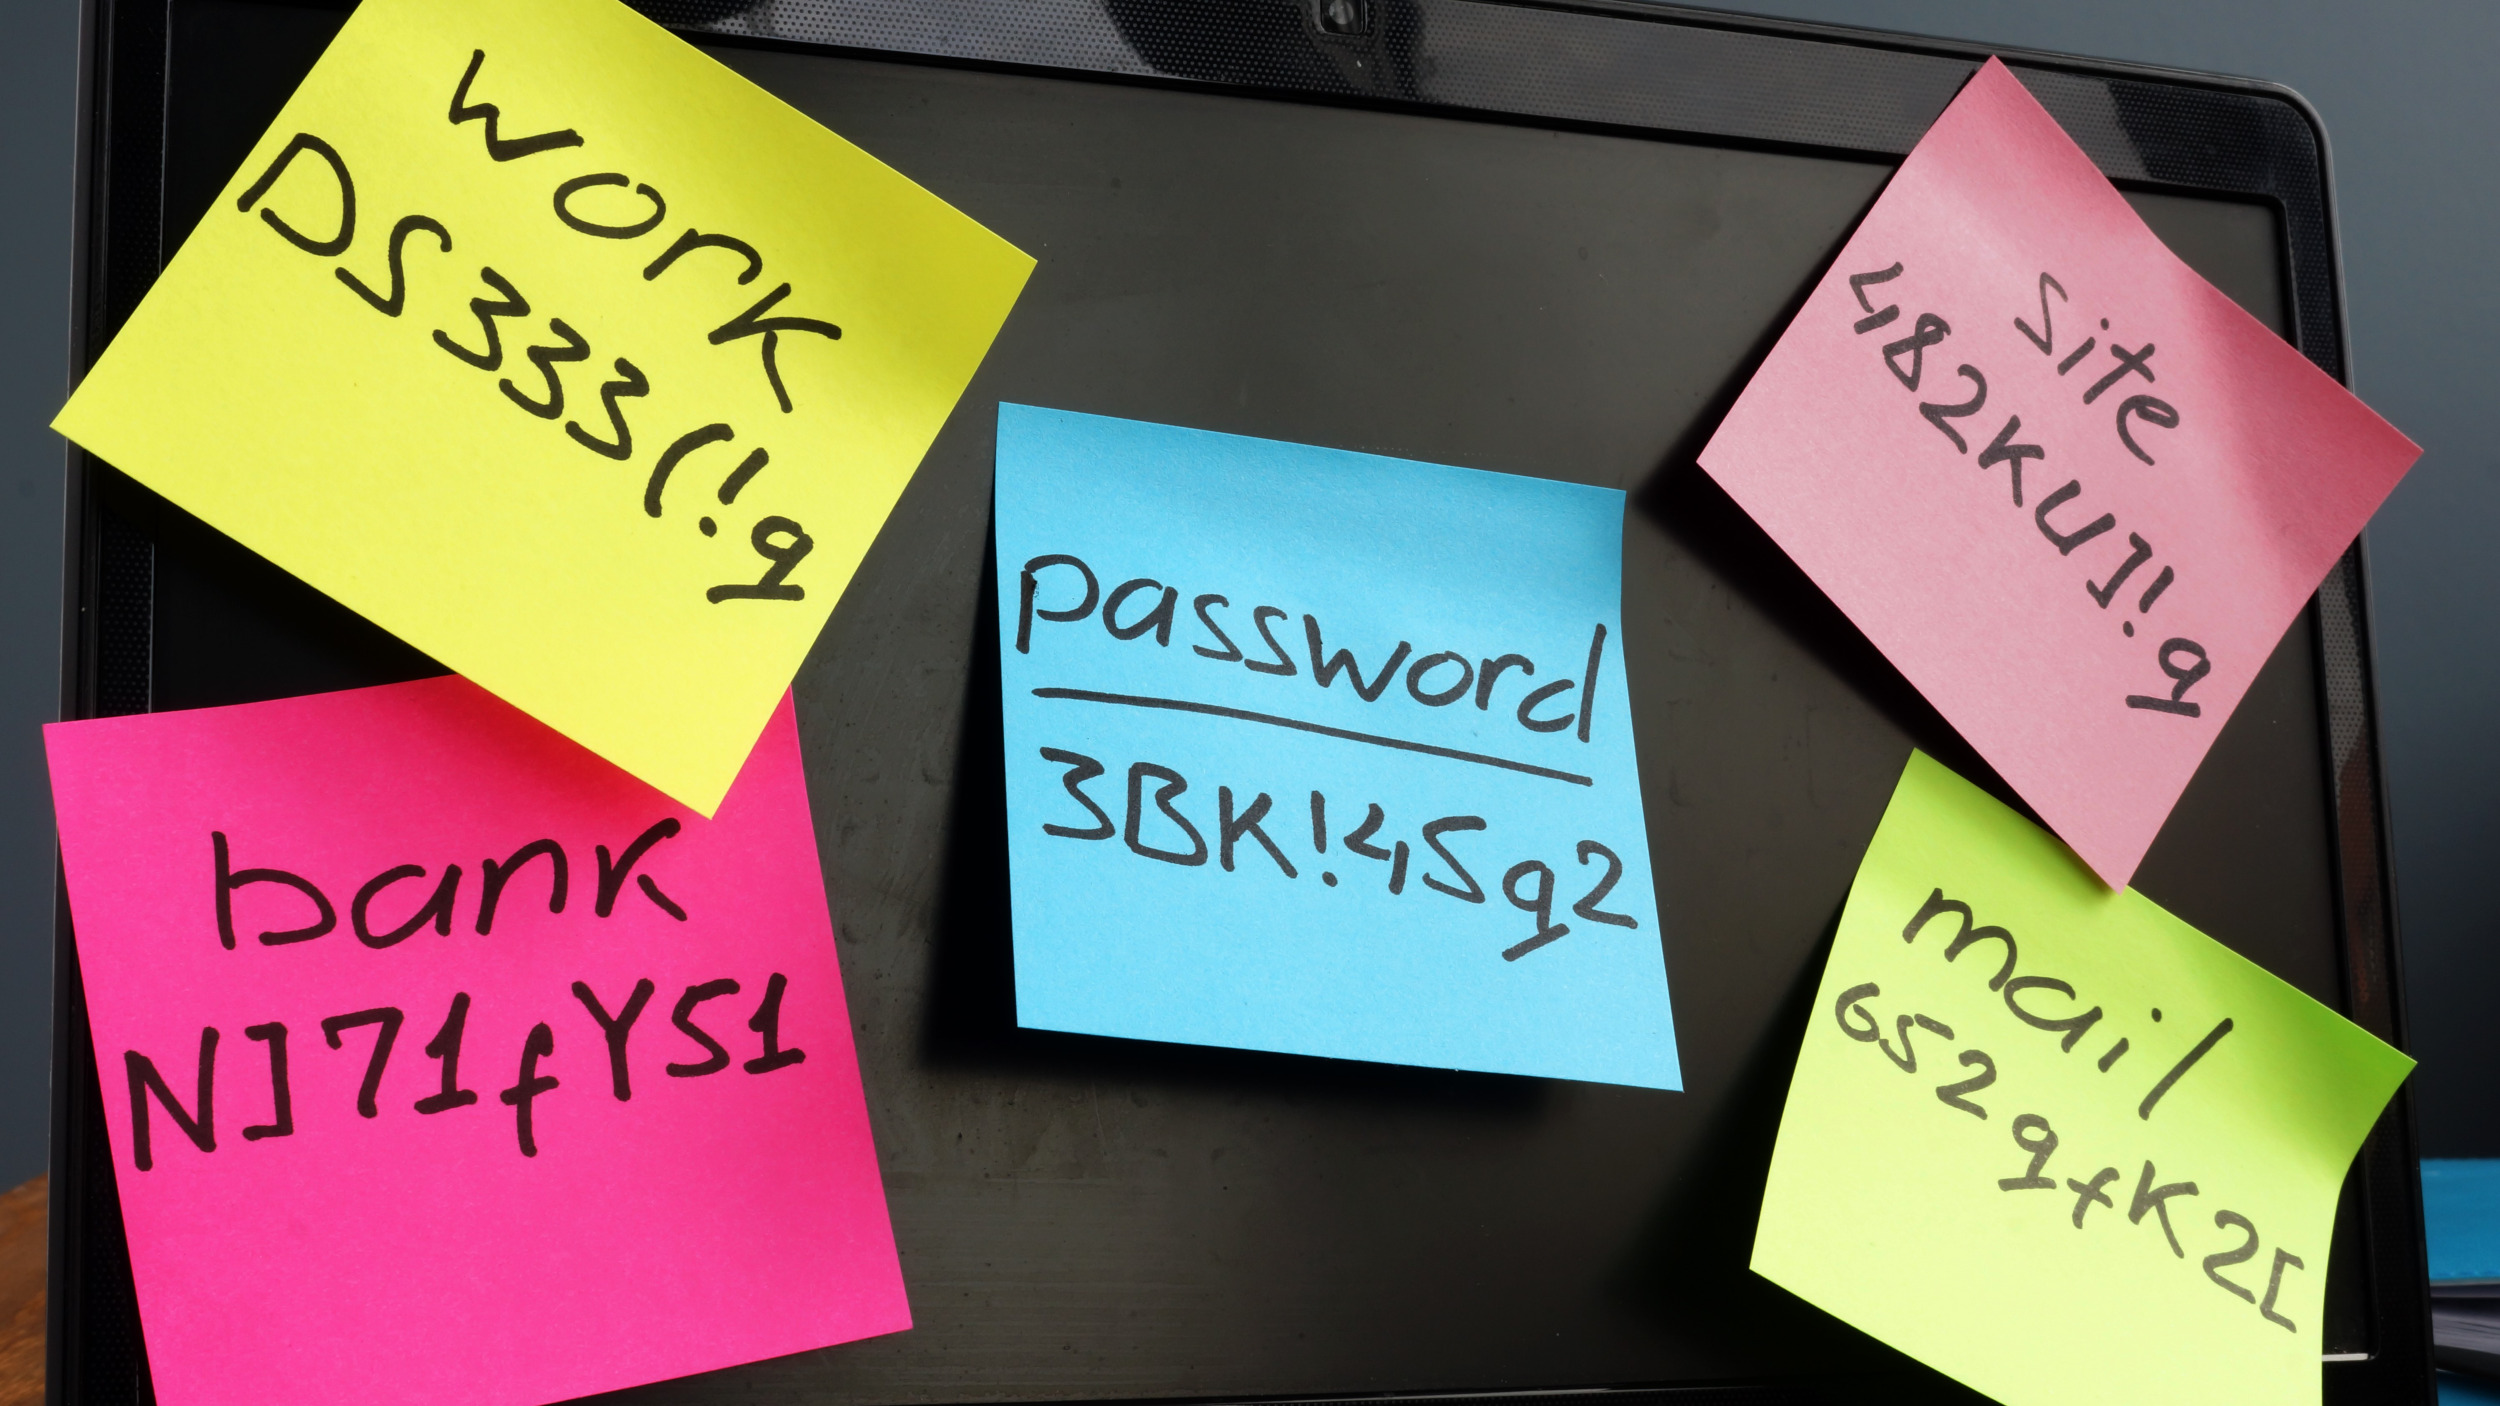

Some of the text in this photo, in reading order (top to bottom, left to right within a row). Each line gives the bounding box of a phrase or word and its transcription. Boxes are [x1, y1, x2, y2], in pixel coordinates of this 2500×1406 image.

[1015, 554, 1607, 743] password
[211, 817, 687, 950] bank
[1902, 887, 2234, 1120] mail
